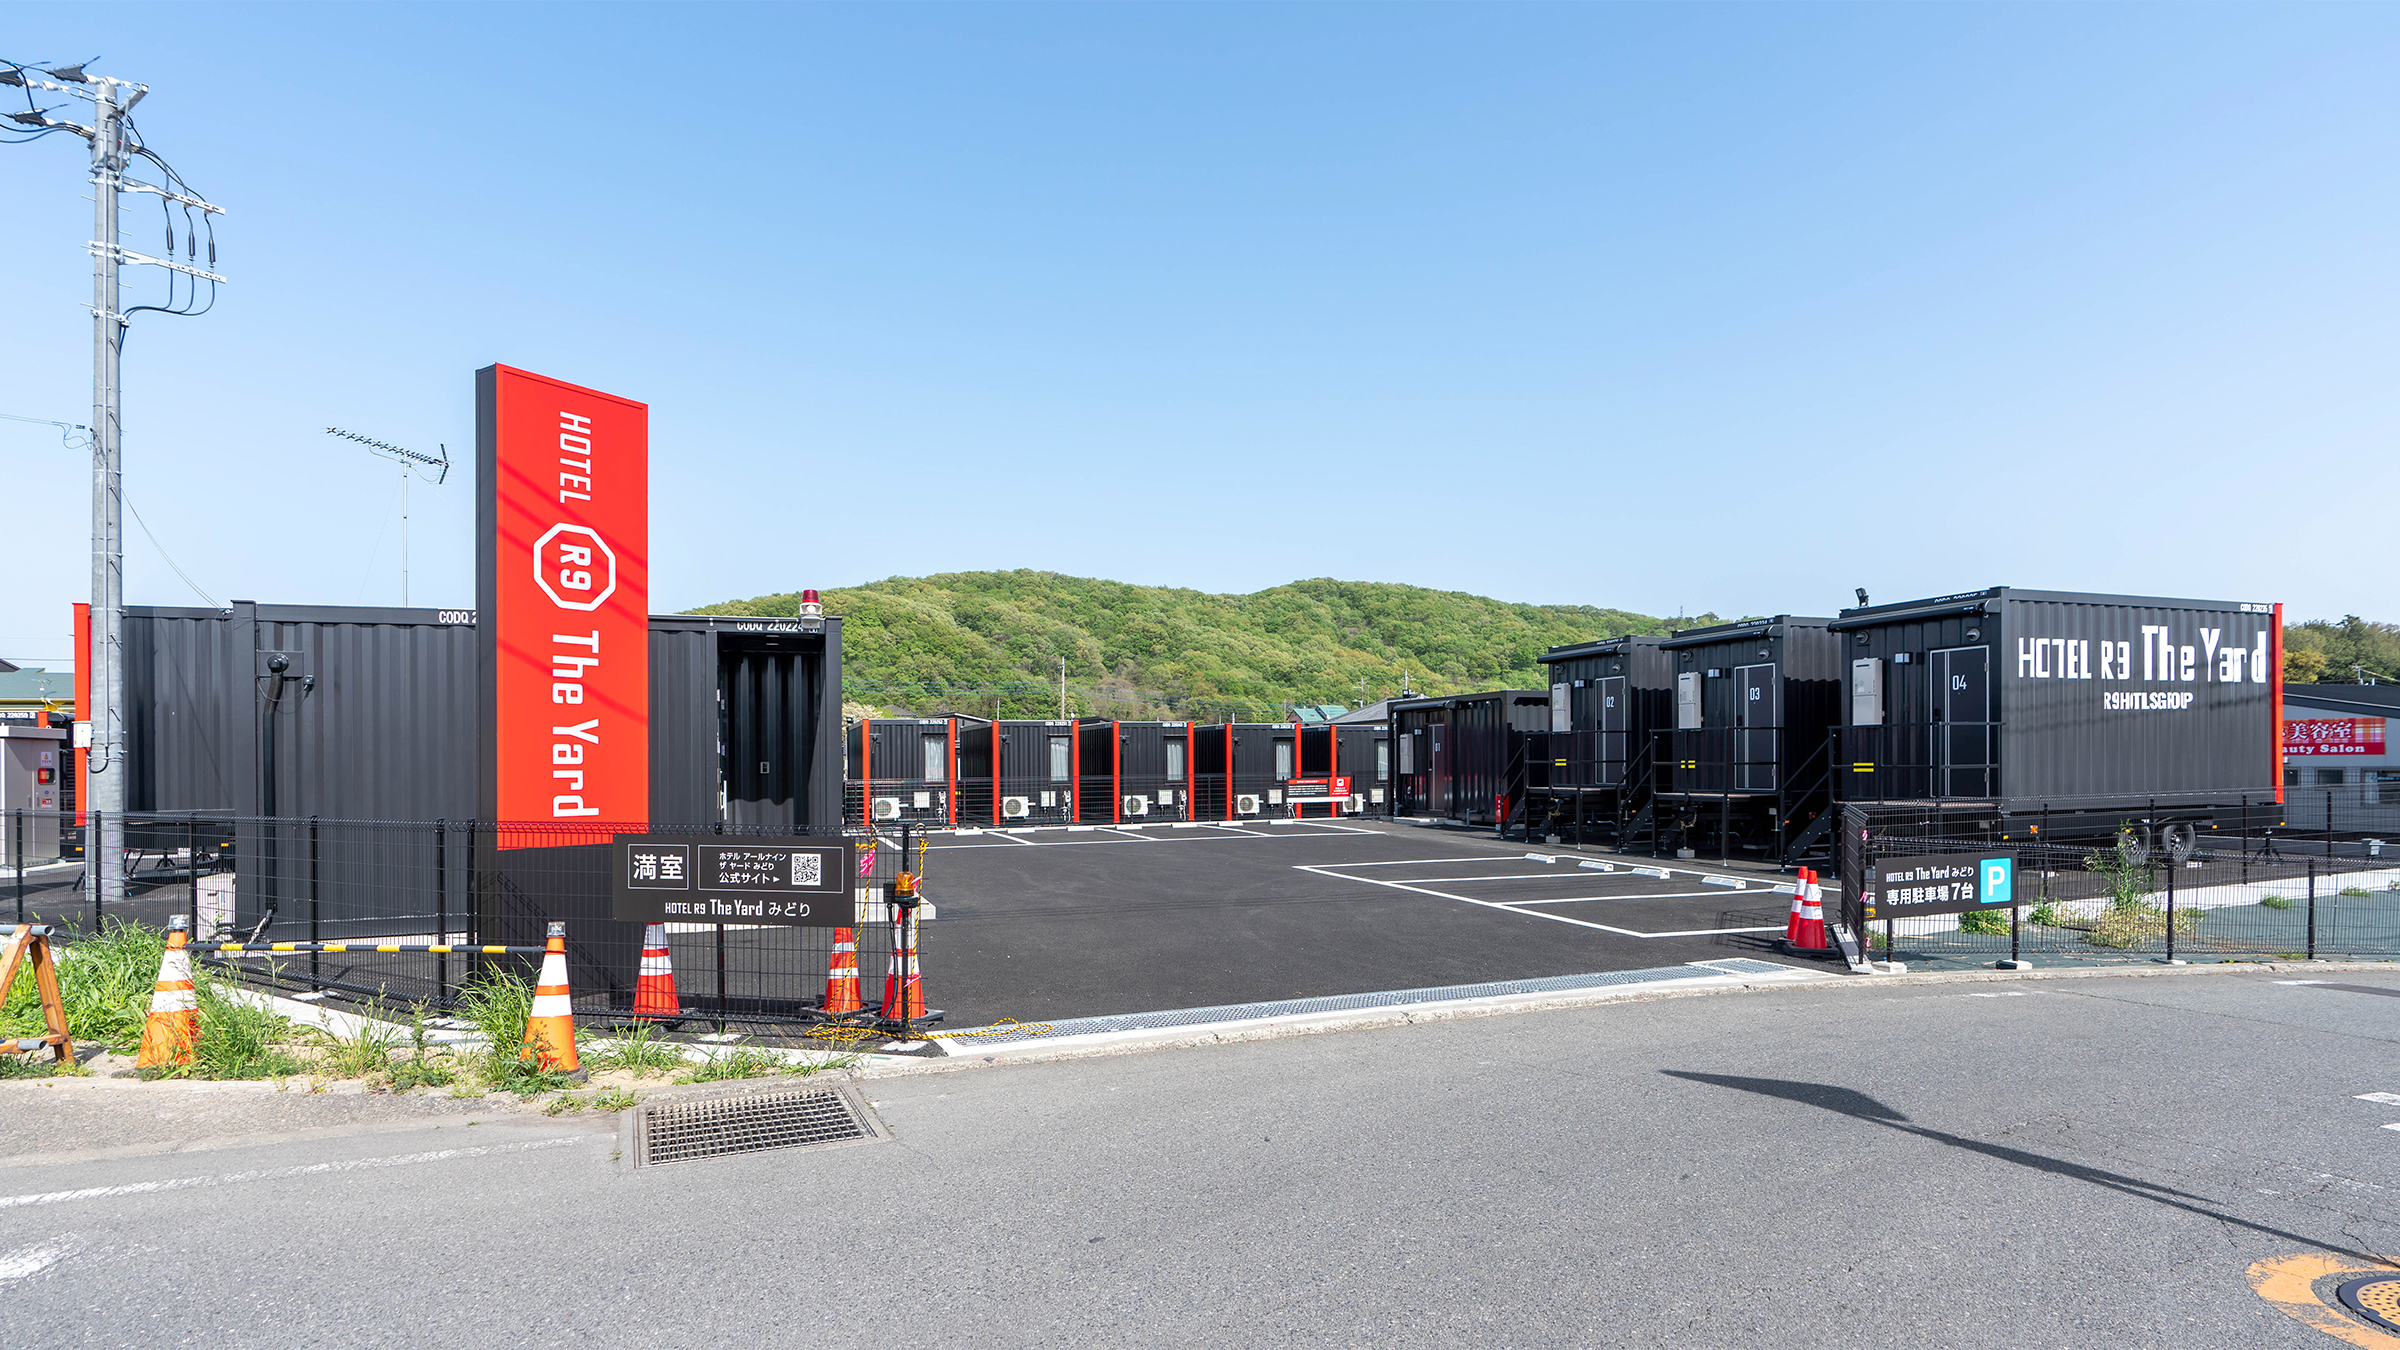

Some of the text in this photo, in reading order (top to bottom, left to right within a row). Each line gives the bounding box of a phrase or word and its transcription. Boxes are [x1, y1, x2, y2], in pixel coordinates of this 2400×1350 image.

[560, 411, 591, 503] HOTEL
[560, 543, 591, 591] R9
[438, 610, 469, 624] CODQ
[2018, 625, 2267, 684] HOTEL R9 The Yard
[1952, 674, 1967, 690] 04
[1606, 696, 1615, 708] 02
[1750, 687, 1760, 700] 03
[552, 630, 599, 818] The Yard
[2289, 722, 2352, 740] 美容室
[2320, 744, 2365, 753] Salon
[719, 852, 787, 862] ホテル アールナイン
[729, 861, 751, 870] ヤード
[753, 862, 775, 871] みどり
[633, 853, 684, 880] 満室
[1886, 872, 1904, 883] HOTEL
[1915, 866, 1930, 881] The
[1931, 865, 1950, 880] Yard
[1951, 866, 1974, 878] みどり
[719, 872, 770, 884] 公式サイト
[1988, 866, 2005, 896] P
[665, 898, 811, 918] HOTEL R9 The Yard みどり
